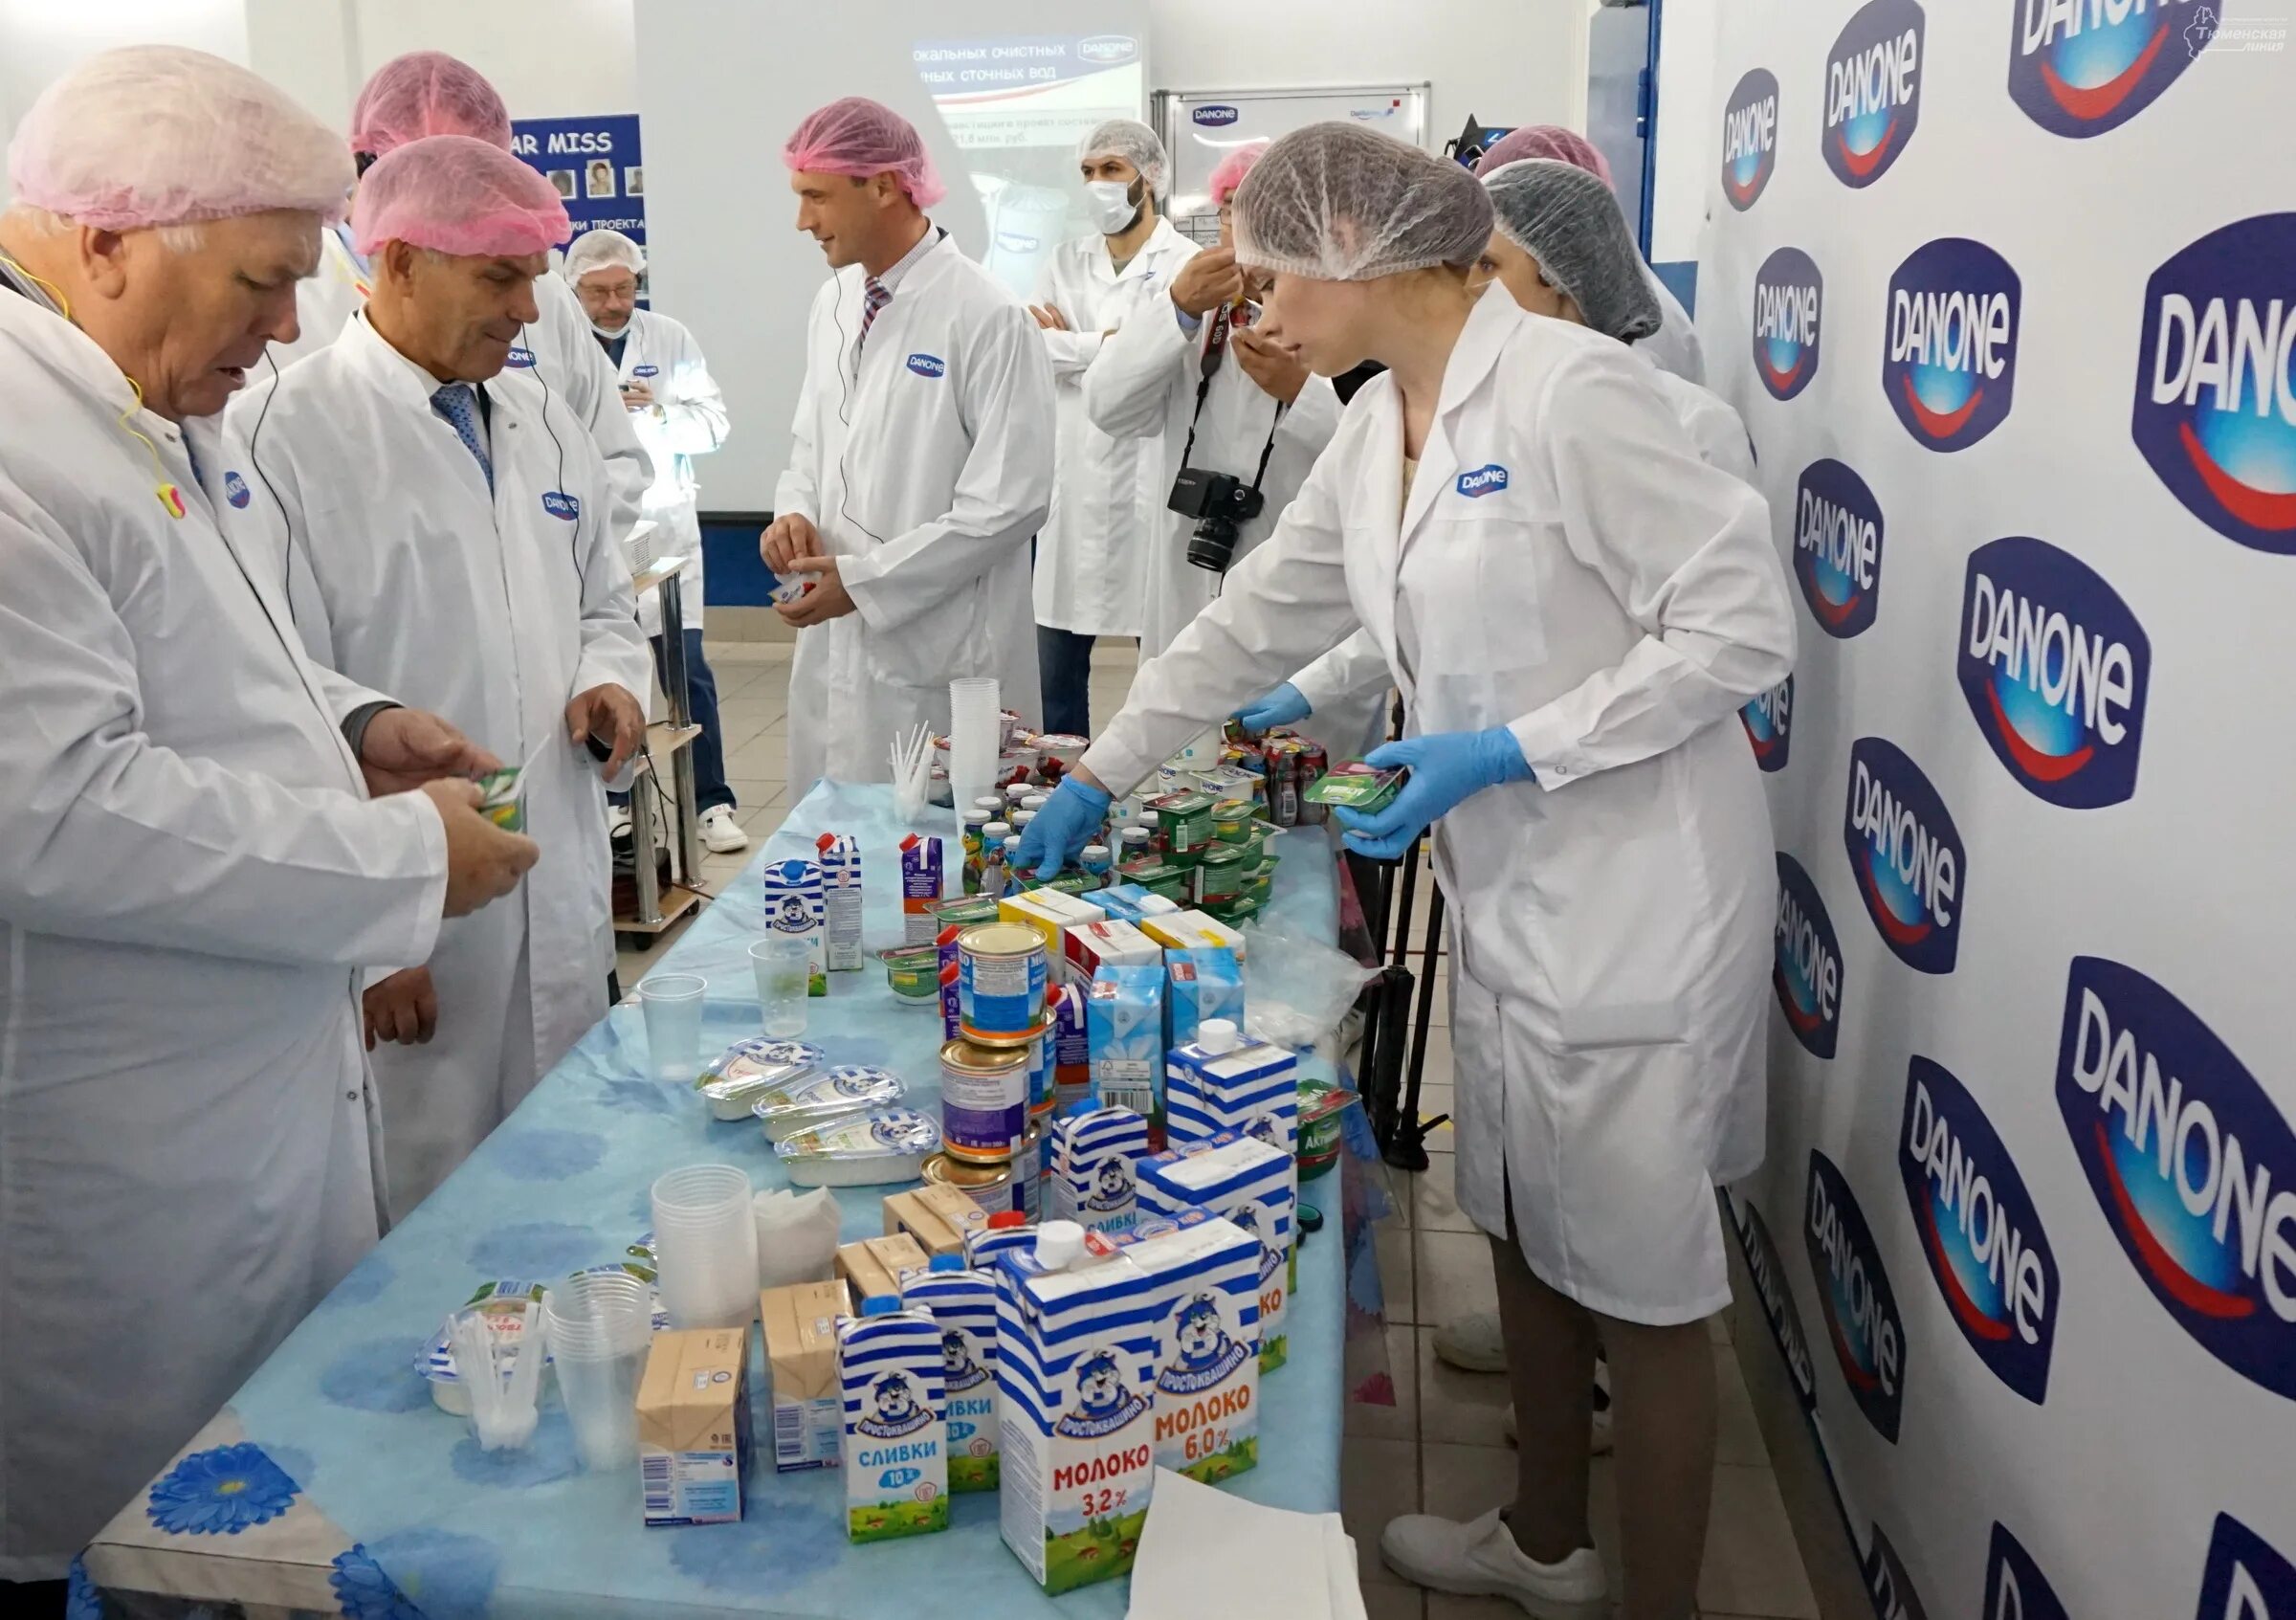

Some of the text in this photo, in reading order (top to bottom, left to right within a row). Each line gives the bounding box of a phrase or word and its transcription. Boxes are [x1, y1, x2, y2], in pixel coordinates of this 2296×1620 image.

[914, 44, 1067, 62] окальных очистных
[960, 68, 1024, 82] сточных
[1029, 66, 1056, 80] вод
[511, 132, 613, 154] AR MISS
[591, 218, 646, 231] ПРОЕКТА
[2152, 292, 2296, 428] DAN
[1776, 888, 1837, 1022] ANONe
[946, 1398, 992, 1416] ИВКИ
[1155, 1385, 1251, 1442] МОЛОКО
[858, 1440, 938, 1467] СЛИВКИ
[1054, 1444, 1150, 1492] МОЛОКО
